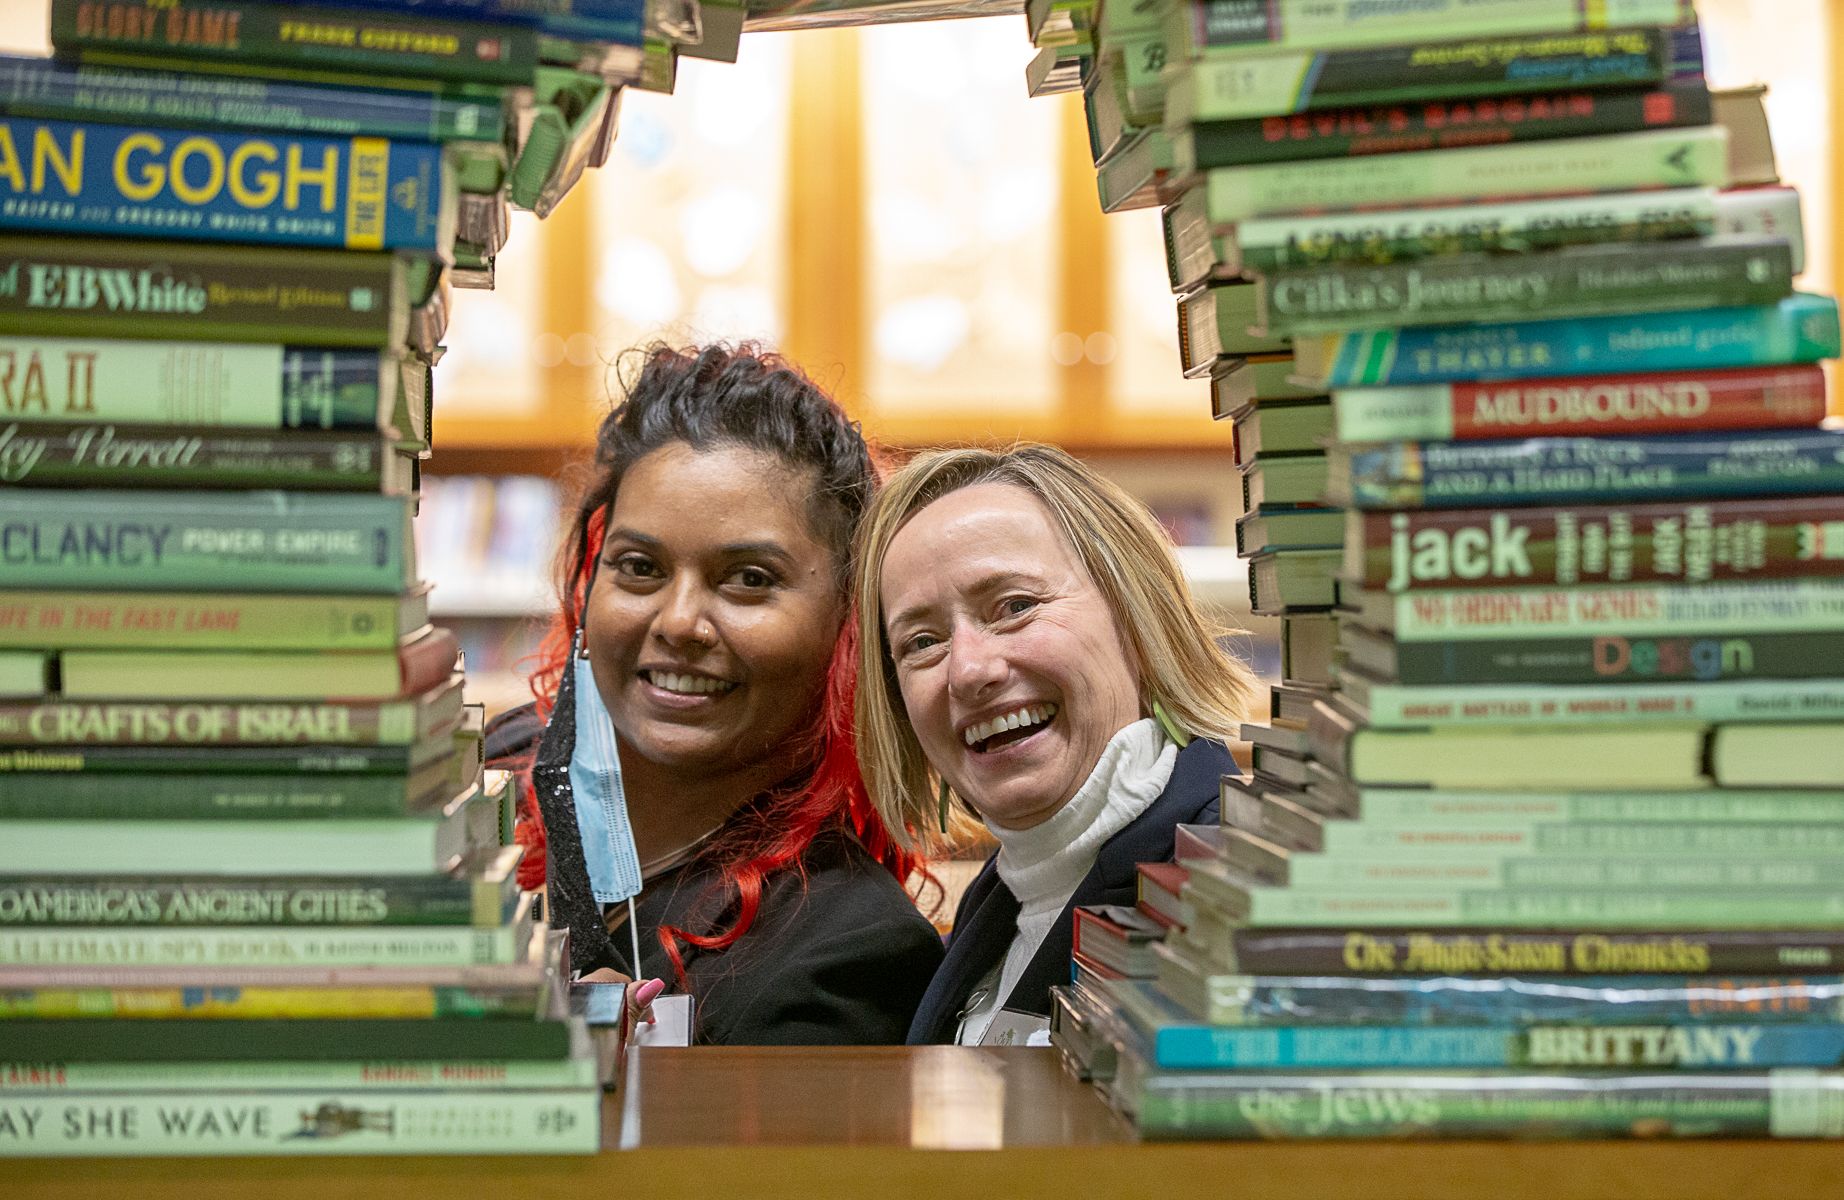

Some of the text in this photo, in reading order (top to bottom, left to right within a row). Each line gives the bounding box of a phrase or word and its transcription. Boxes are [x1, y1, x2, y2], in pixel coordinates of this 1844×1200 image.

[1262, 95, 1594, 142] DEVIL'S BARGAIN
[0, 123, 86, 197] AN
[113, 132, 339, 213] GOGH
[1274, 267, 1551, 315] Cilka's Journey
[1415, 342, 1551, 375] THAYER
[1472, 381, 1711, 426] MUDBOUND
[2, 522, 172, 568] CLANCY
[182, 528, 265, 554] POWER
[277, 529, 363, 555] EMPIRE
[1387, 511, 1532, 592] jack
[39, 608, 64, 629] IN
[74, 607, 112, 630] THE
[123, 608, 177, 631] FAST
[184, 609, 241, 632] LANE
[29, 704, 170, 742] CRAFTS
[173, 704, 234, 742] OF
[237, 704, 352, 742] ISRAEL
[166, 888, 285, 922] ANCIENT
[289, 888, 388, 922] CITIES
[12, 936, 153, 965] ULTIMATE
[161, 936, 208, 965] SPY
[1572, 934, 1711, 971] Chronicles
[1527, 1026, 1762, 1065] BRITTANY
[0, 1106, 272, 1140] AY SHE WAVE
[1304, 1080, 1440, 1134] Jews
